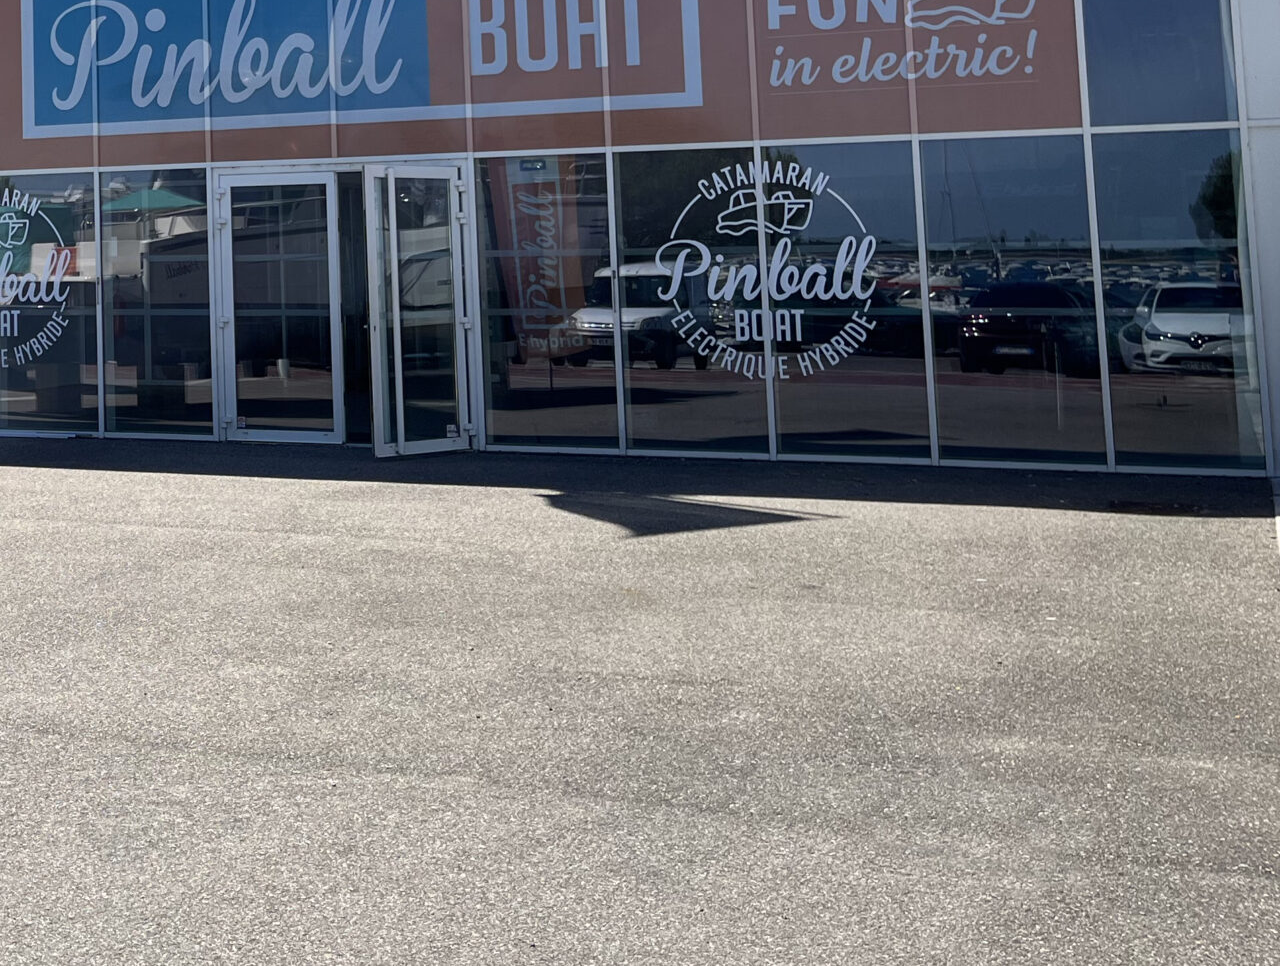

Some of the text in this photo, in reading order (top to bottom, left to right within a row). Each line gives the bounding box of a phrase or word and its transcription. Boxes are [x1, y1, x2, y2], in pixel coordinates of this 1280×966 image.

[768, 29, 1038, 87] in electric!
[698, 161, 830, 201] CATAMARAN
[517, 190, 559, 319] Pinball
[655, 235, 878, 302] Pinball
[13, 311, 69, 366] HYBRIDE
[671, 309, 877, 380] ELECTRIQUE HYBRIDE
[735, 309, 805, 342] BOAT
